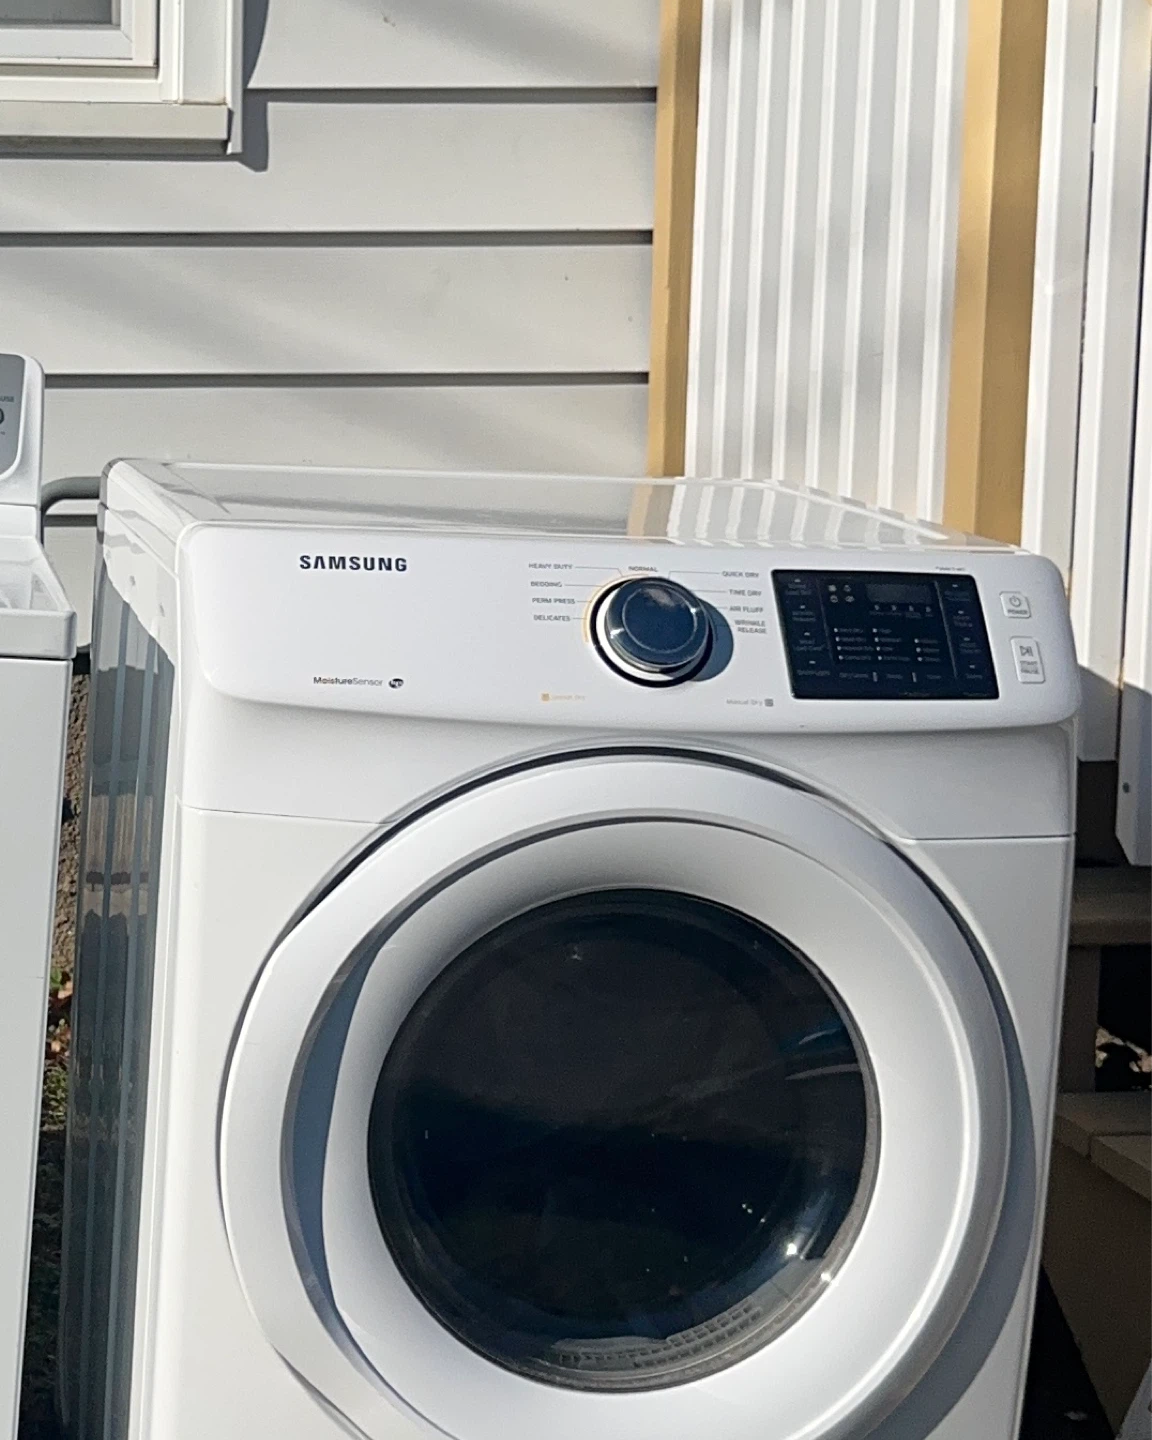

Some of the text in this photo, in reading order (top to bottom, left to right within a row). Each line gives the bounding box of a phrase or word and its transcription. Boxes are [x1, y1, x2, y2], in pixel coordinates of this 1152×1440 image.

[299, 554, 408, 572] SAMSUNG
[628, 565, 658, 573] NORMAL
[533, 614, 571, 622] DELICATES
